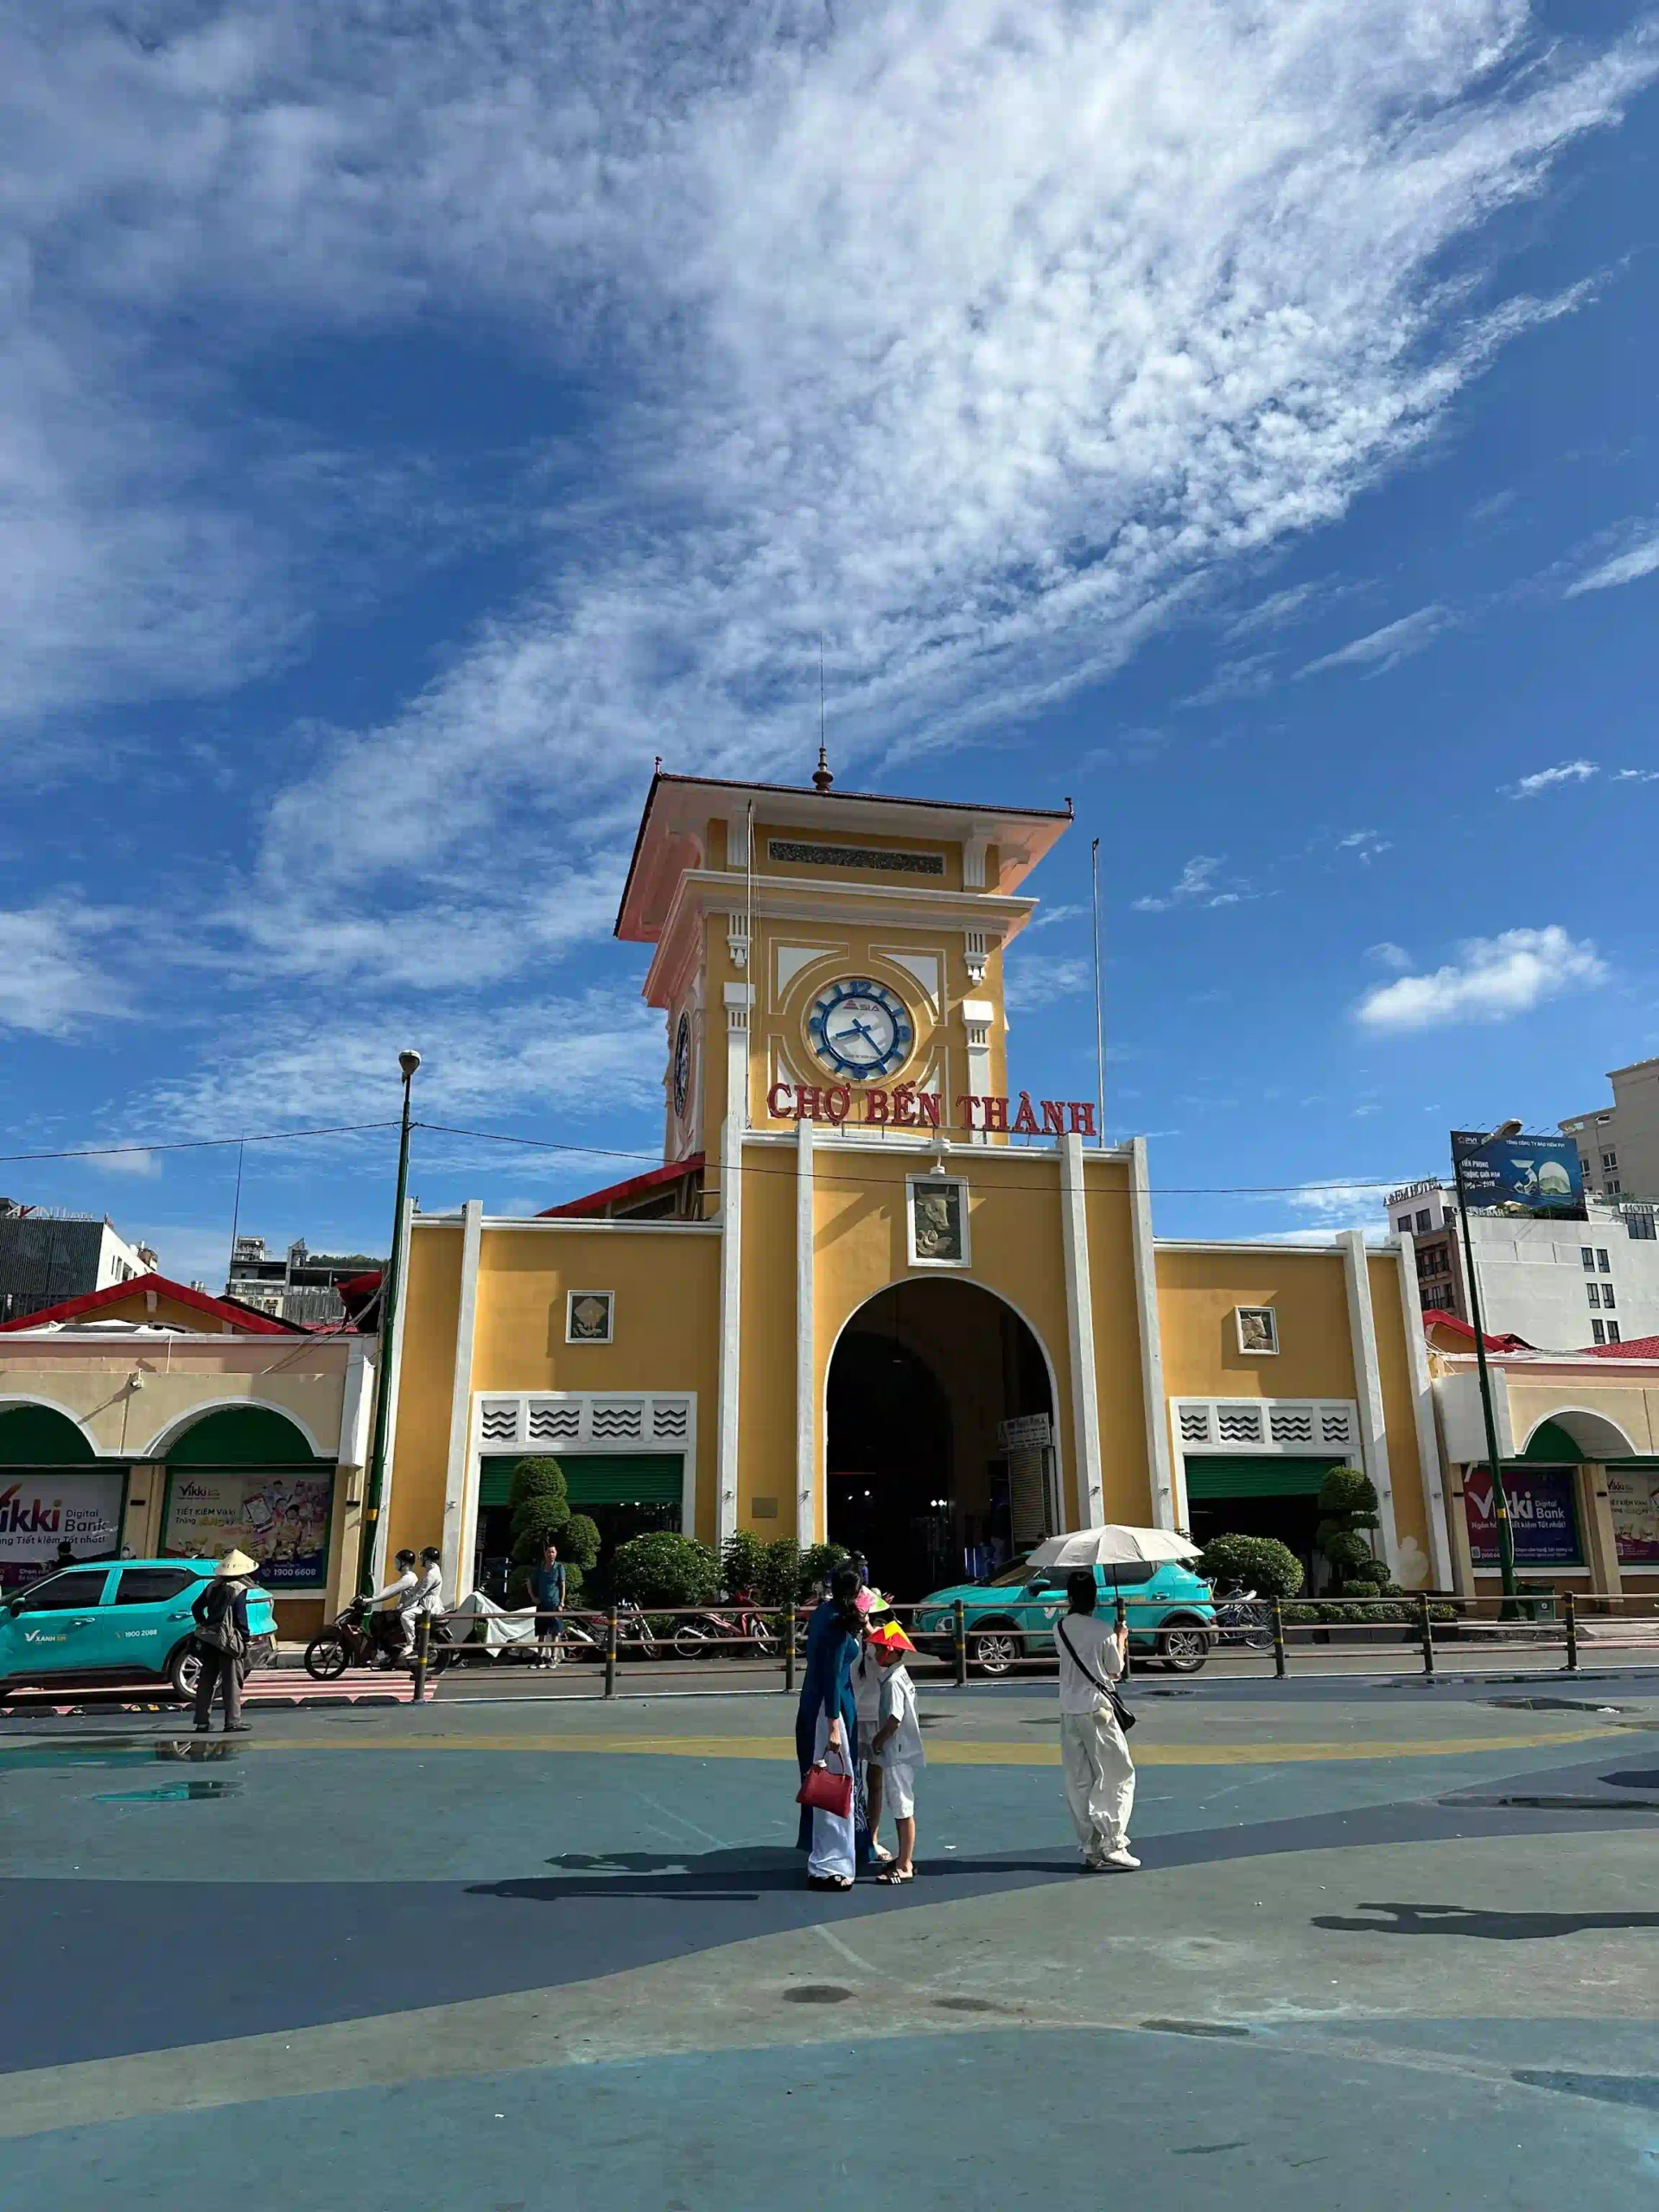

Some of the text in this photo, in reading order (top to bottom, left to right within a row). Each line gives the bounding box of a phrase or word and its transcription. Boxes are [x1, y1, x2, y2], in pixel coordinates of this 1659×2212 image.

[766, 1080, 1096, 1136] CHỢ BẾN THÀNH
[5, 1205, 67, 1218] AVANTI
[179, 1481, 207, 1496] Vikki
[67, 1510, 99, 1519] Digital
[1536, 1508, 1565, 1518] Bank
[16, 1535, 35, 1544] Tiết
